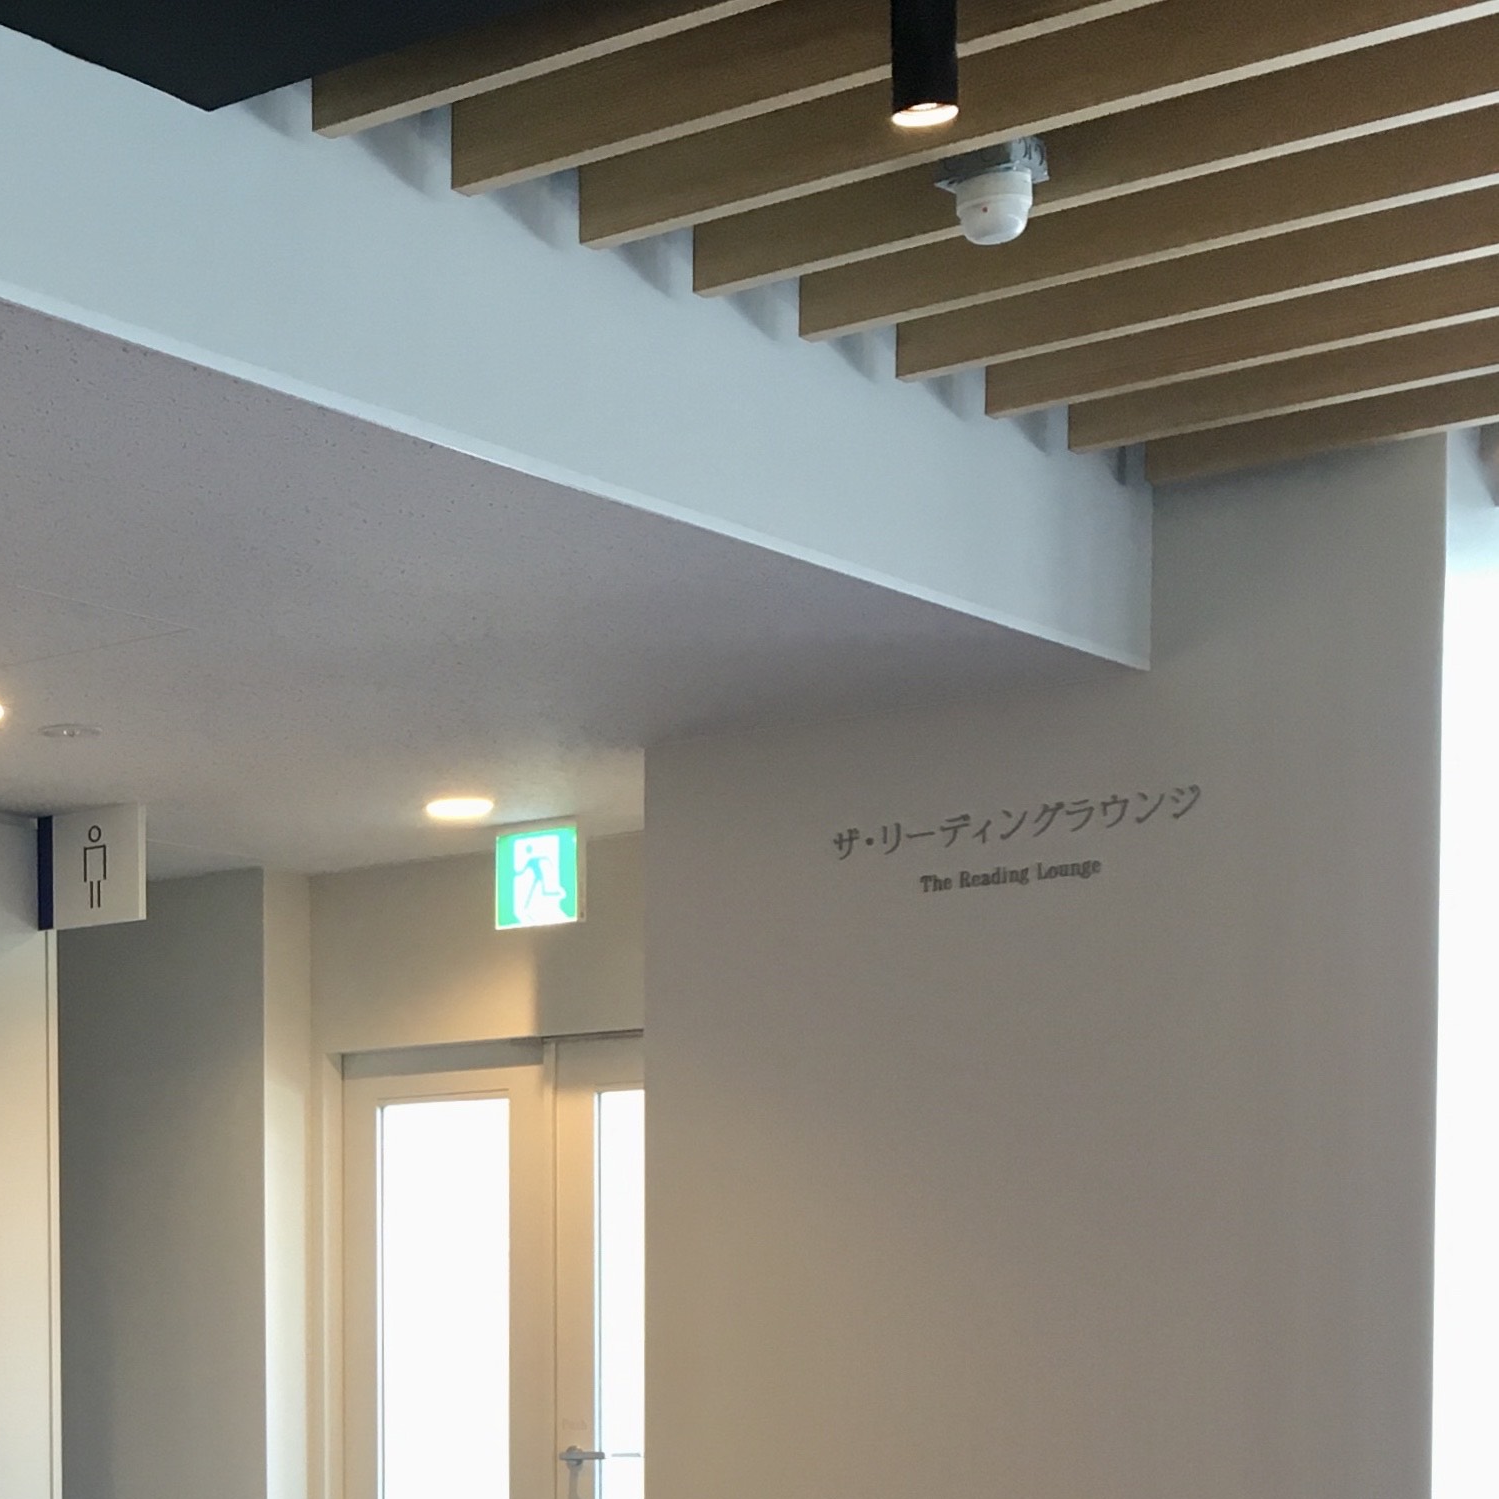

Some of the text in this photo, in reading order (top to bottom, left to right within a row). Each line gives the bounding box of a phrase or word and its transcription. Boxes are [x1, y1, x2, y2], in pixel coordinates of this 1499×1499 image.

[833, 784, 1202, 860] ザ・リーディングラウンジ
[920, 860, 1101, 893] The Reading Lounge
